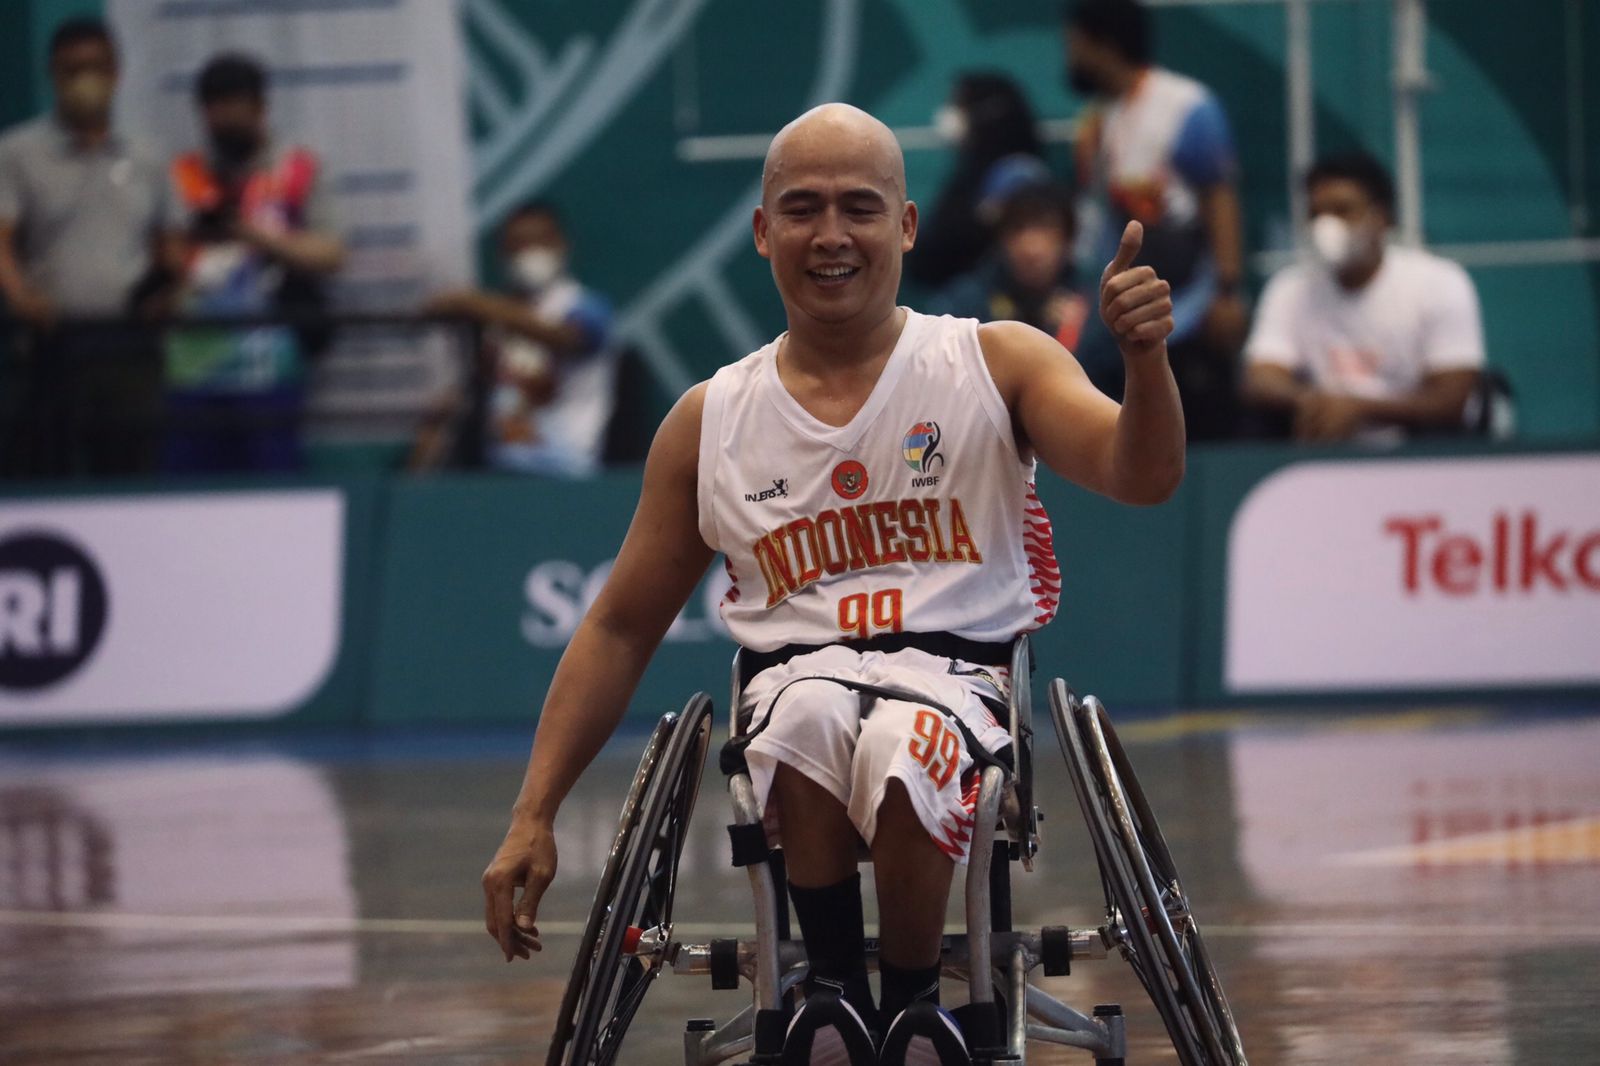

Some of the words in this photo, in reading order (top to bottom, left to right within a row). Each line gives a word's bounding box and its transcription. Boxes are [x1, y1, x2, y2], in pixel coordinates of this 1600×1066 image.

[911, 475, 940, 488] IWBF
[752, 498, 983, 609] INDONESIA
[838, 588, 903, 640] 99
[908, 709, 960, 793] 99
